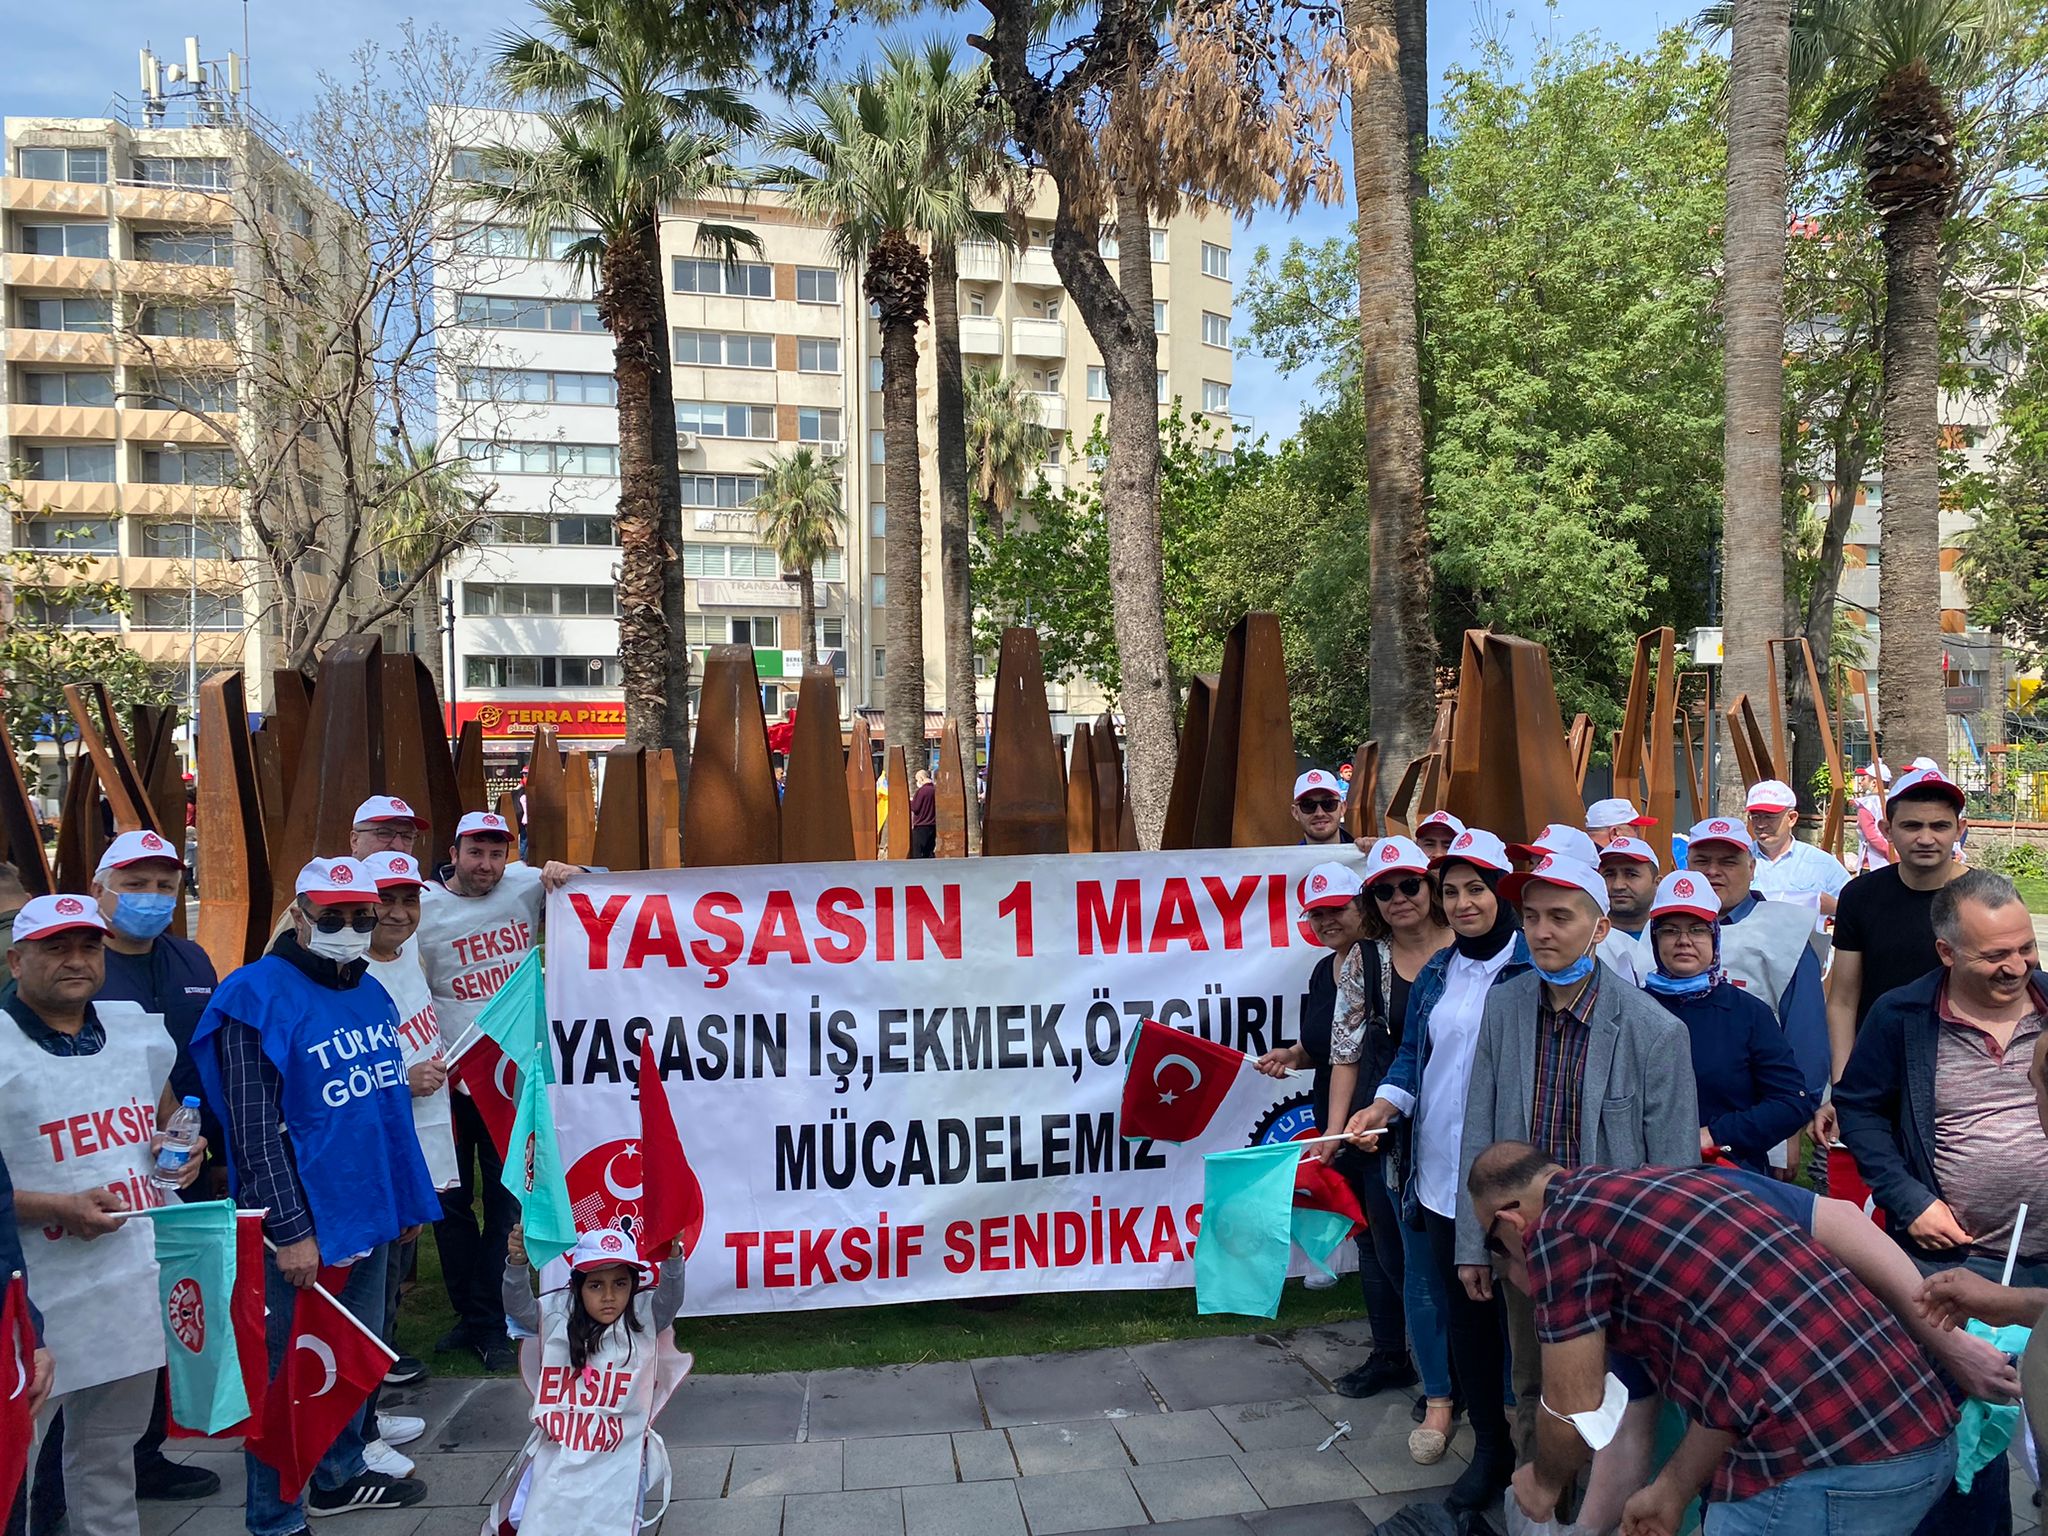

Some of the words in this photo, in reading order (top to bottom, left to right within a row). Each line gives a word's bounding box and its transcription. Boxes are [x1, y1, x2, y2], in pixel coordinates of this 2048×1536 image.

[507, 710, 574, 722] TERRA
[452, 919, 530, 966] TEKSİF
[567, 884, 962, 989] YAŞASIN
[998, 880, 1034, 957] 1
[552, 1013, 787, 1101] YAŞASIN
[39, 1096, 155, 1163] TEKSİF
[725, 1211, 924, 1289] TEKSİF
